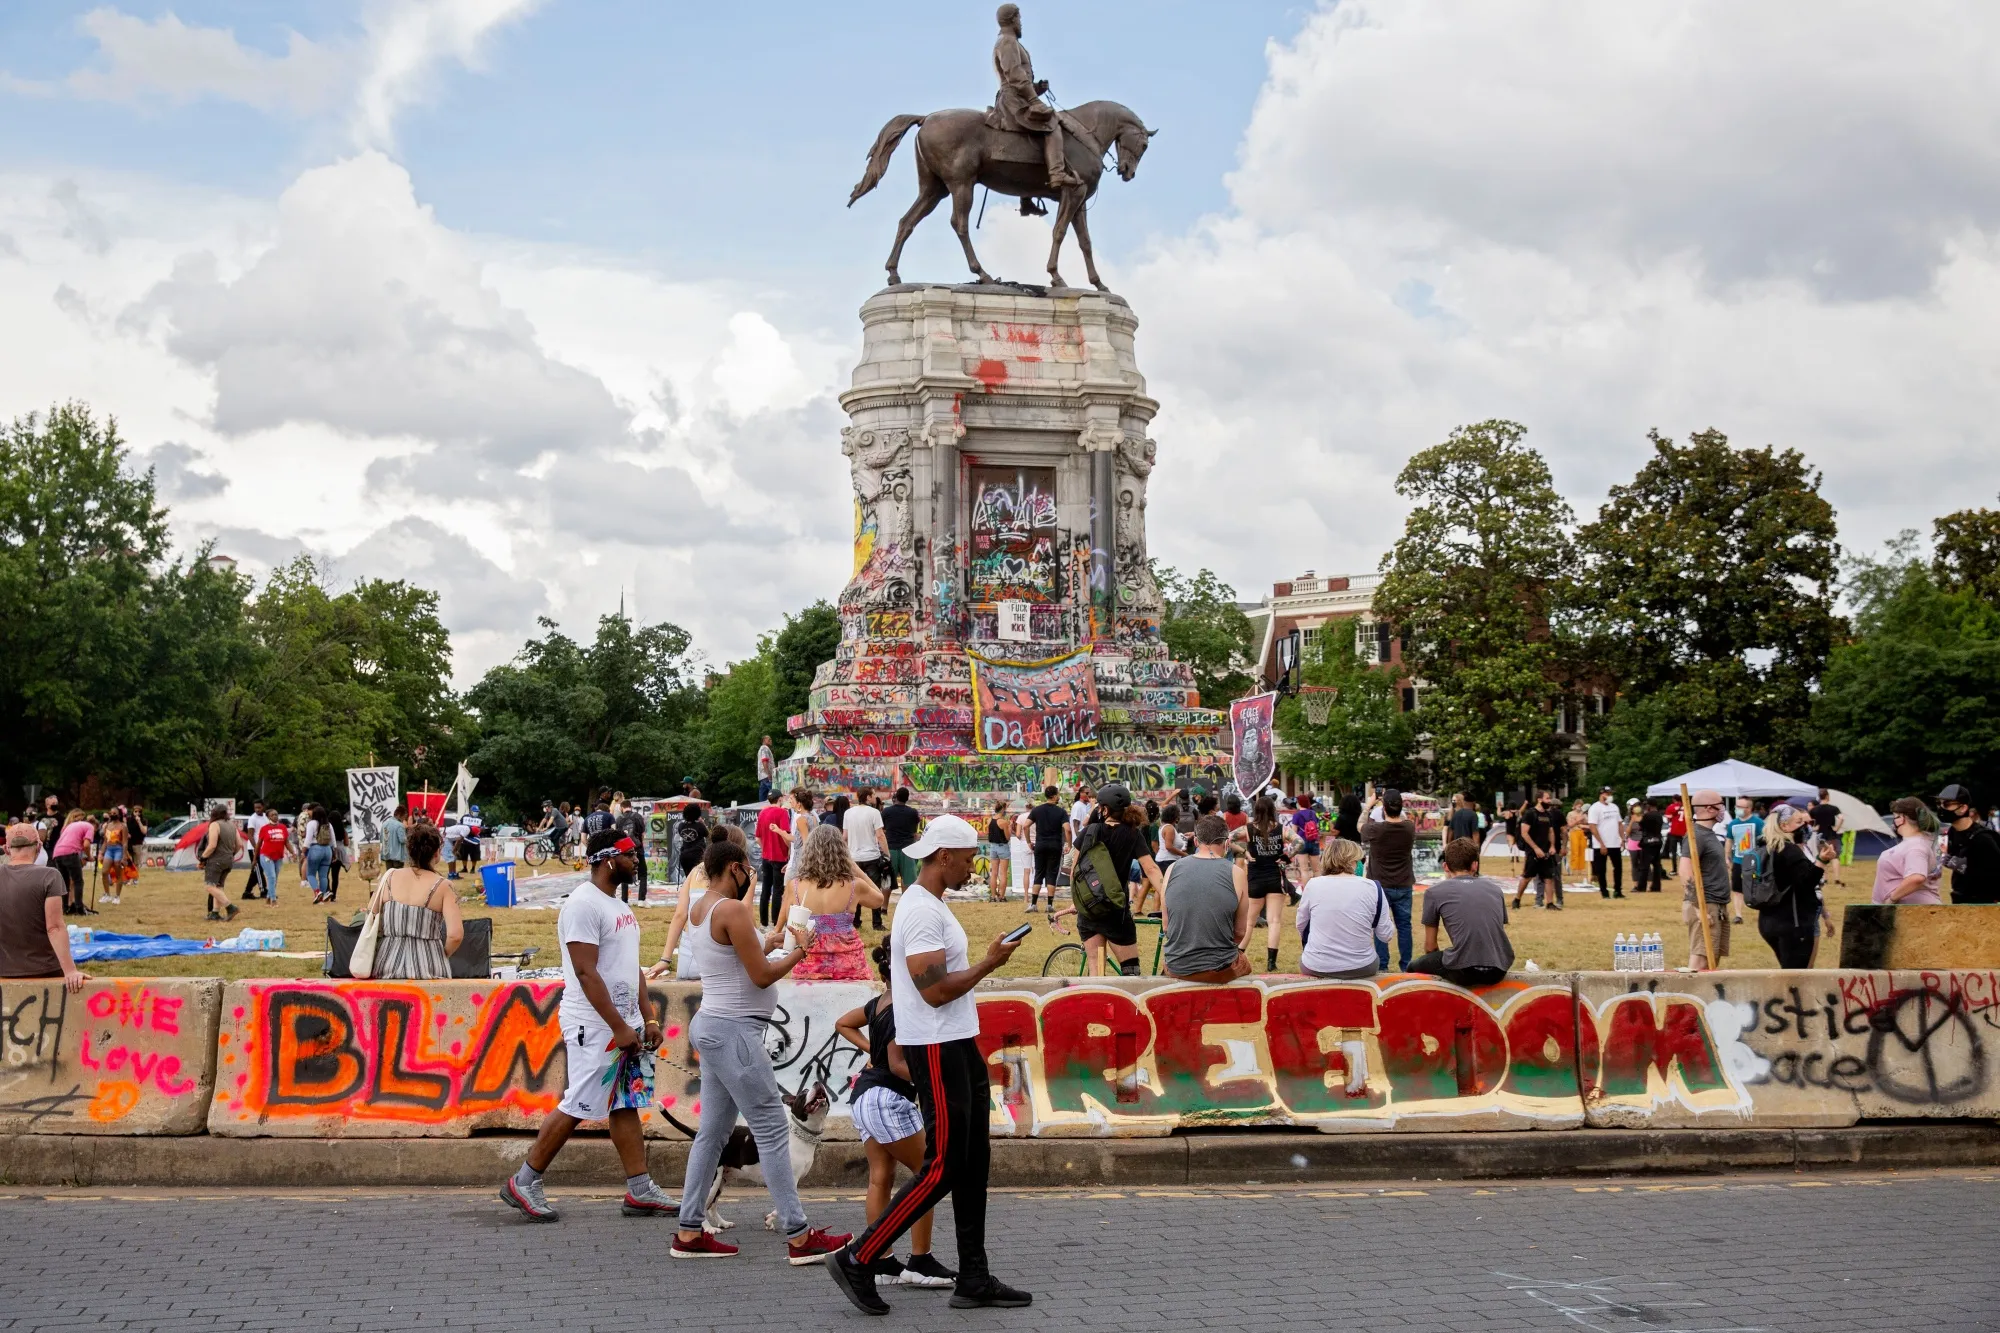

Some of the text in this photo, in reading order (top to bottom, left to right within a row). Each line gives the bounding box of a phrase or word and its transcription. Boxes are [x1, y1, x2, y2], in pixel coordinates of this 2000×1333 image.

[1010, 603, 1028, 612] FUCK
[1013, 613, 1026, 622] THE
[866, 612, 910, 629] 757
[1011, 623, 1026, 632] KKK
[871, 628, 909, 638] LOVE
[986, 677, 1089, 711] FUCK
[1192, 710, 1223, 724] ICE!
[983, 716, 1027, 750] Da
[350, 771, 395, 797] HOW
[360, 780, 396, 806] MUCH
[87, 989, 184, 1036] ONE
[266, 984, 572, 1110] BLM
